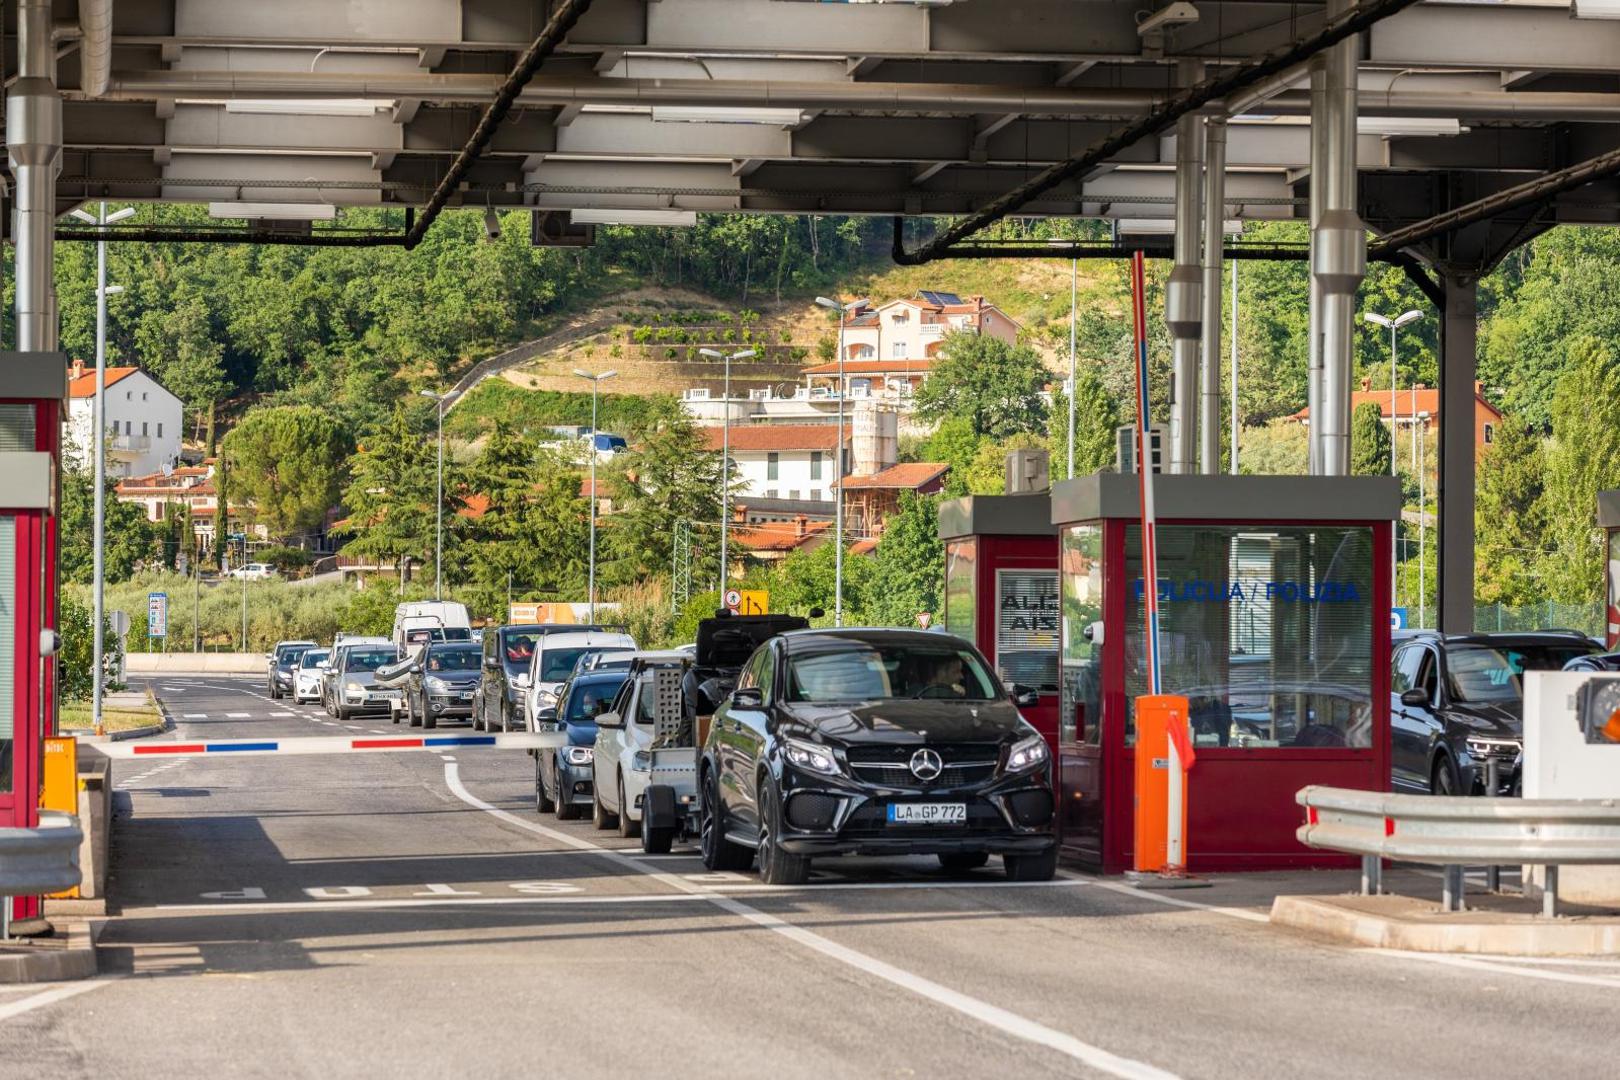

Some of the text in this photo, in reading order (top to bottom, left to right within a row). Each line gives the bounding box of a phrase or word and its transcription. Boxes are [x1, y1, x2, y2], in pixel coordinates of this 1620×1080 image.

[1266, 581, 1361, 602] POLIZIA
[896, 805, 965, 820] LA GP 772
